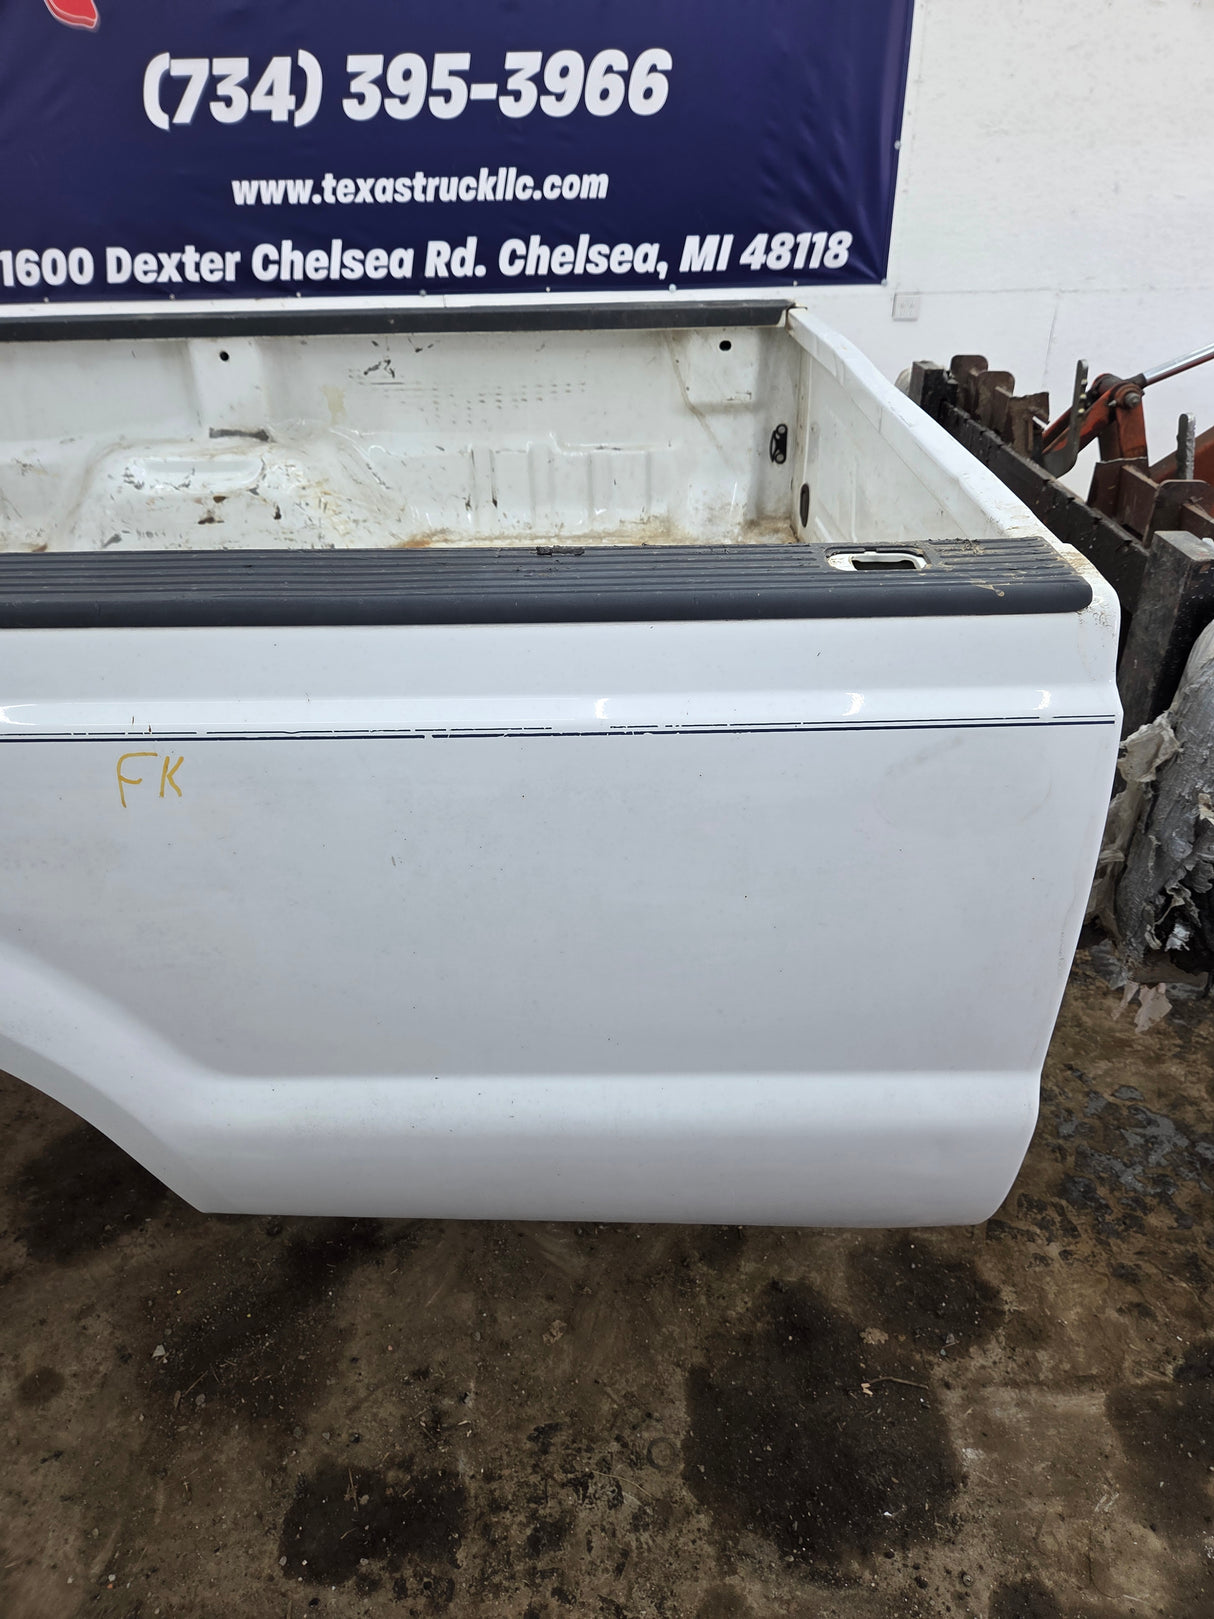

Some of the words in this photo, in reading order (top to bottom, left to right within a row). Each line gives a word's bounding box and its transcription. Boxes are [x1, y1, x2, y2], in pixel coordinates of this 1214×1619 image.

[143, 49, 323, 130] (734)
[342, 49, 672, 120] 395-3966
[231, 166, 609, 206] www.texastruckllc.com
[105, 244, 240, 284] Dexter
[251, 239, 416, 283] Chelsea
[424, 236, 488, 279] Rd.
[498, 234, 670, 283] Chelsea,
[679, 234, 733, 273] MI
[740, 231, 852, 270] 48118
